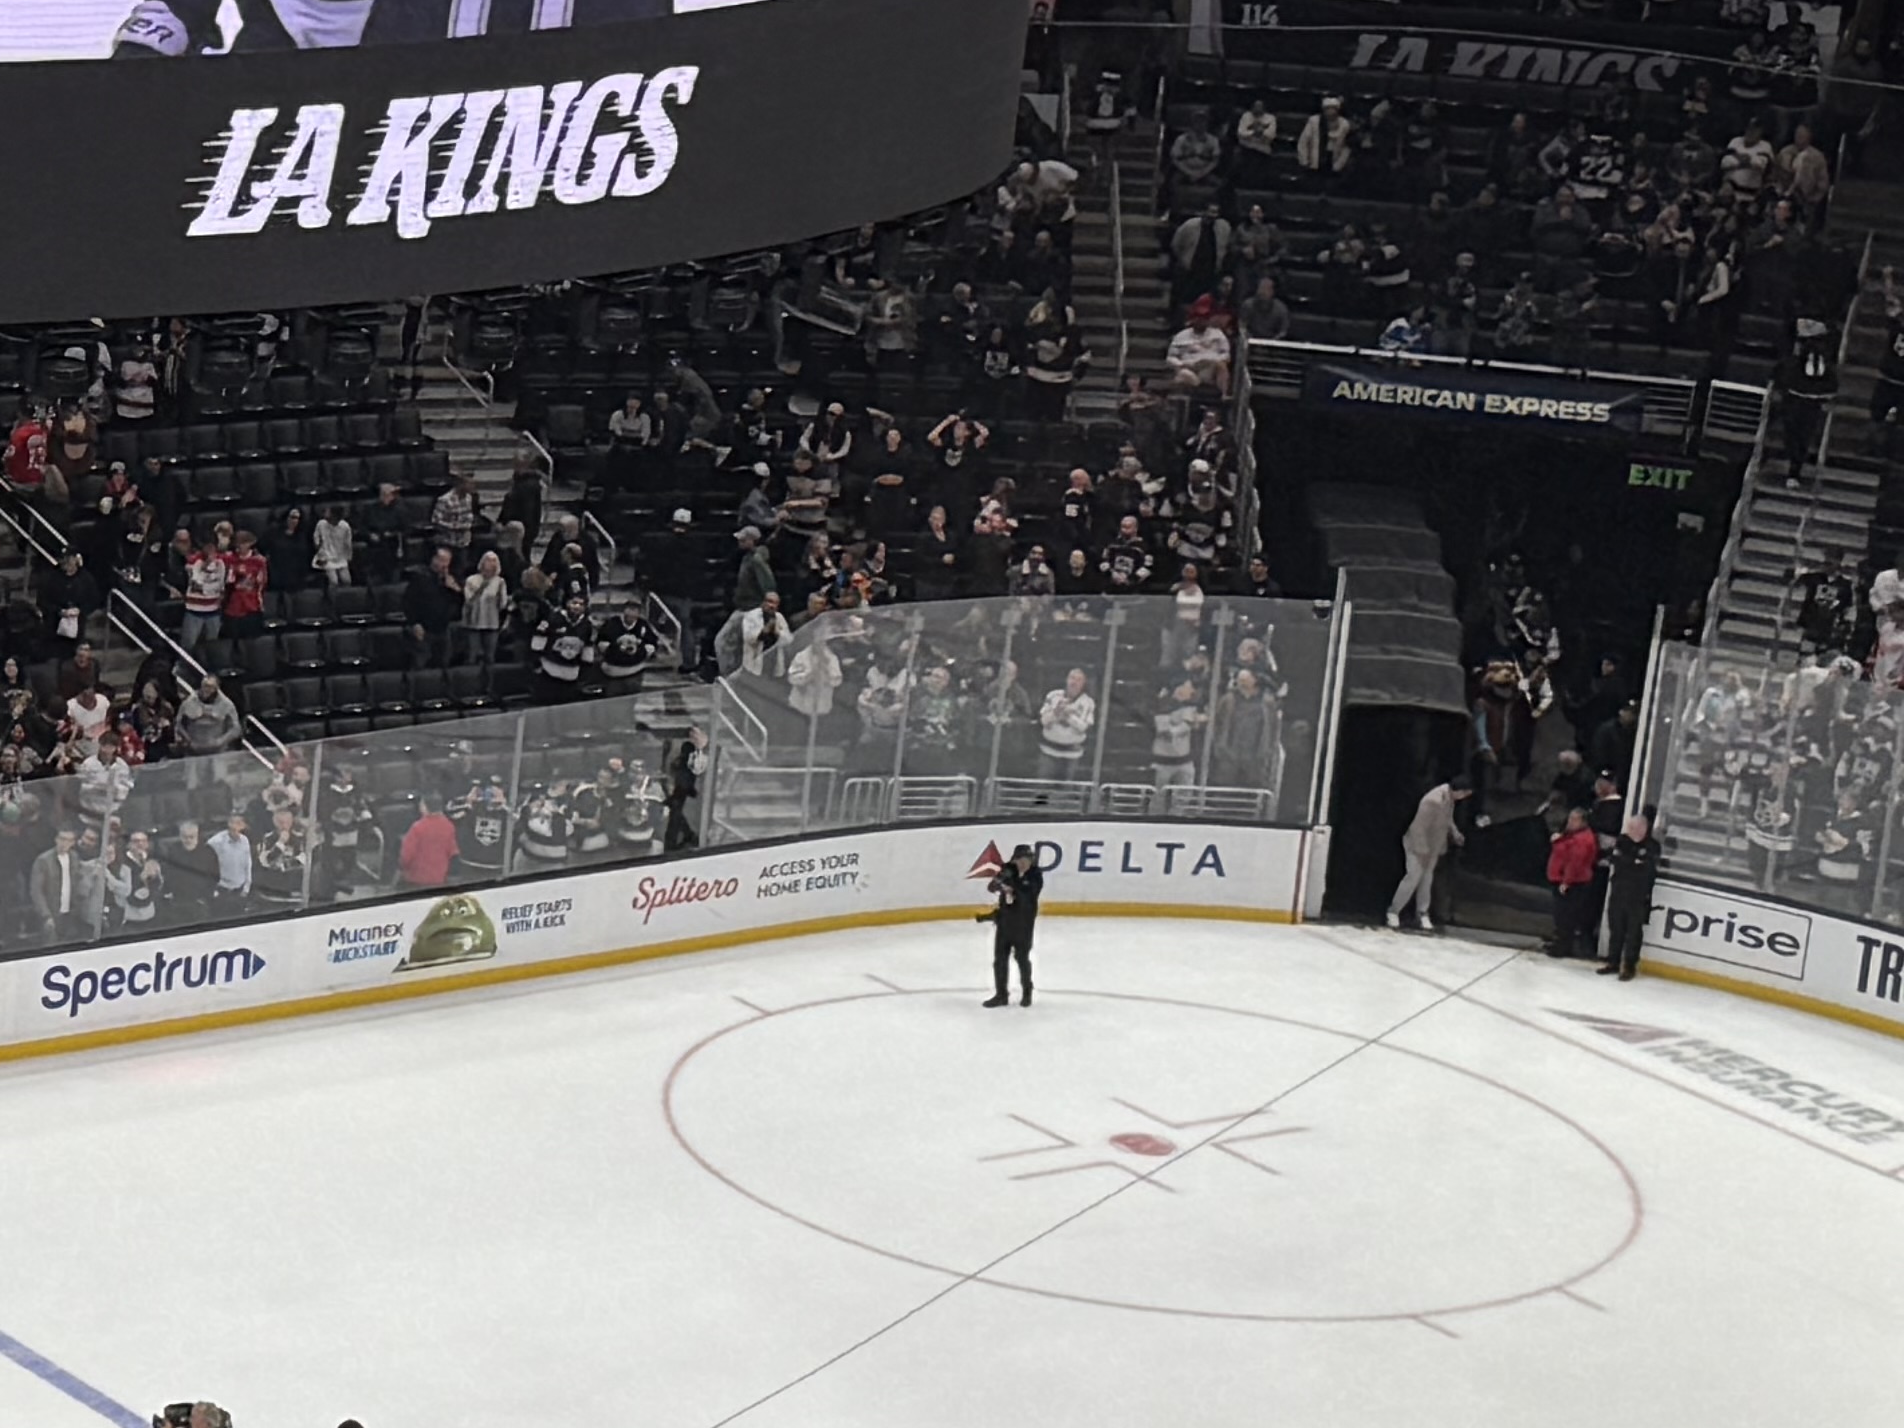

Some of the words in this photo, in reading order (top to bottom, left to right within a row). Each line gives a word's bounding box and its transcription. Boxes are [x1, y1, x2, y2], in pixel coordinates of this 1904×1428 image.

[183, 102, 346, 238] LA
[347, 65, 699, 240] KINGS
[1332, 380, 1476, 412] AMERICAN
[1484, 393, 1612, 423] EXPRESS
[1627, 463, 1691, 491] EXIT
[759, 858, 815, 881] ACCESS
[821, 852, 860, 871] YOUR
[1033, 840, 1226, 879] DELTA
[631, 875, 740, 926] Splitero
[757, 878, 801, 899] HOME
[804, 871, 860, 895] EQUITY
[328, 920, 404, 948] Mucinex
[332, 939, 399, 965] KICKSTART
[40, 947, 253, 1018] Spectrum
